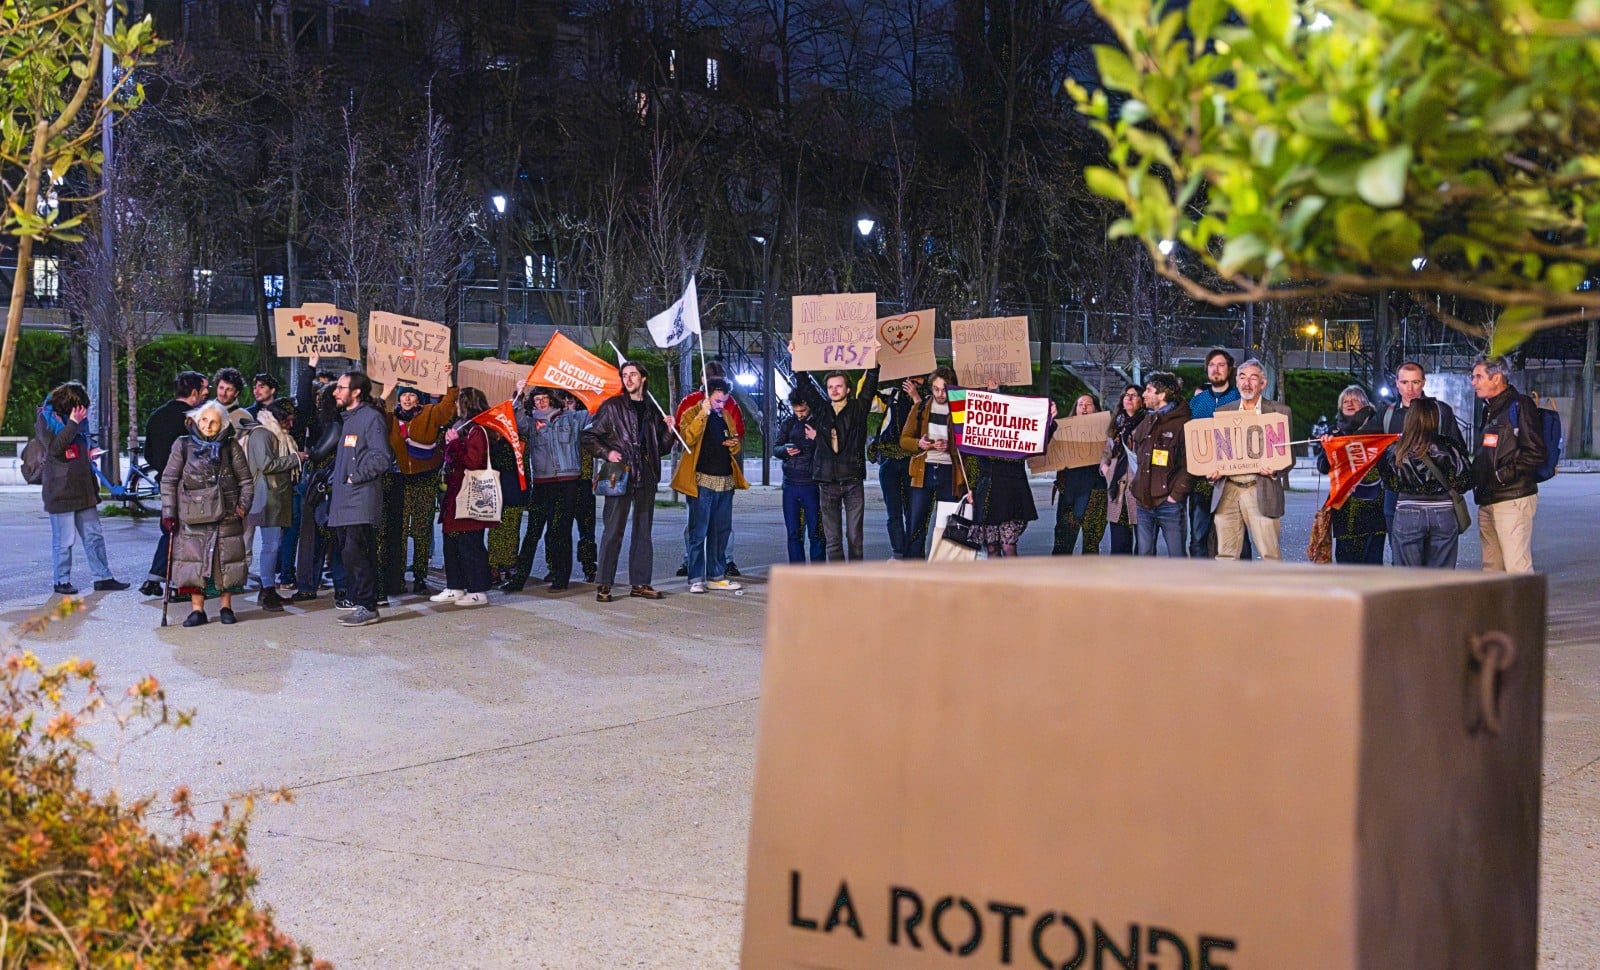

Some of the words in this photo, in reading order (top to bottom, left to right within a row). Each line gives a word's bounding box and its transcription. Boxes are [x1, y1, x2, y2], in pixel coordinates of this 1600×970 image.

[323, 315, 344, 326] MOI
[299, 335, 331, 345] UNION
[332, 334, 341, 343] DE
[374, 323, 447, 354] UNISSEZ
[956, 320, 1026, 344] GARDONS
[297, 345, 308, 354] LA
[311, 344, 347, 354] GAUCHE
[557, 359, 607, 388] VICTOIRES
[967, 398, 1010, 415] FRONT
[966, 411, 1039, 432] POPULAIRE
[965, 425, 1020, 441] BELLEVILLE
[1190, 421, 1286, 463] UNION
[789, 870, 864, 939] LA
[889, 885, 1238, 970] ROTONDE
